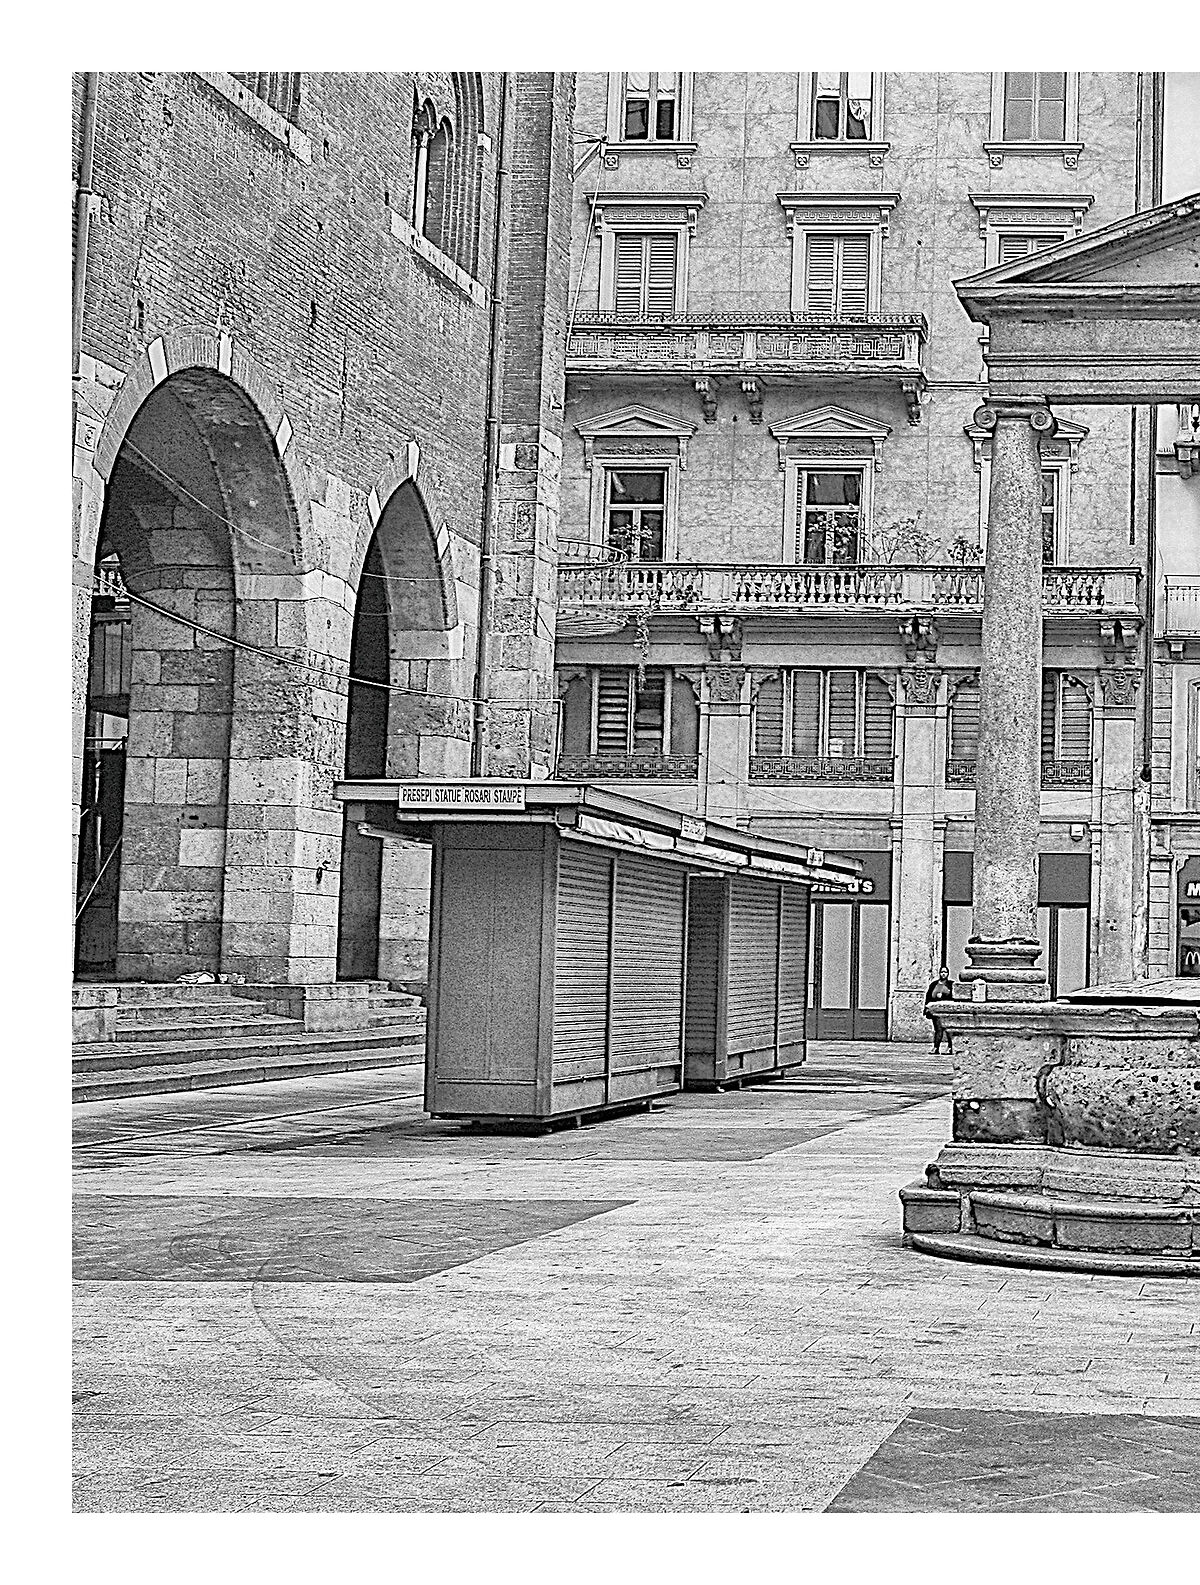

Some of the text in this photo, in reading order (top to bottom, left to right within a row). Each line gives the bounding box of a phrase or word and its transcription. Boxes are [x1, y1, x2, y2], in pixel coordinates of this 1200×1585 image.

[402, 788, 522, 804] PRESEPI STATUE ROSARI STAMPE
